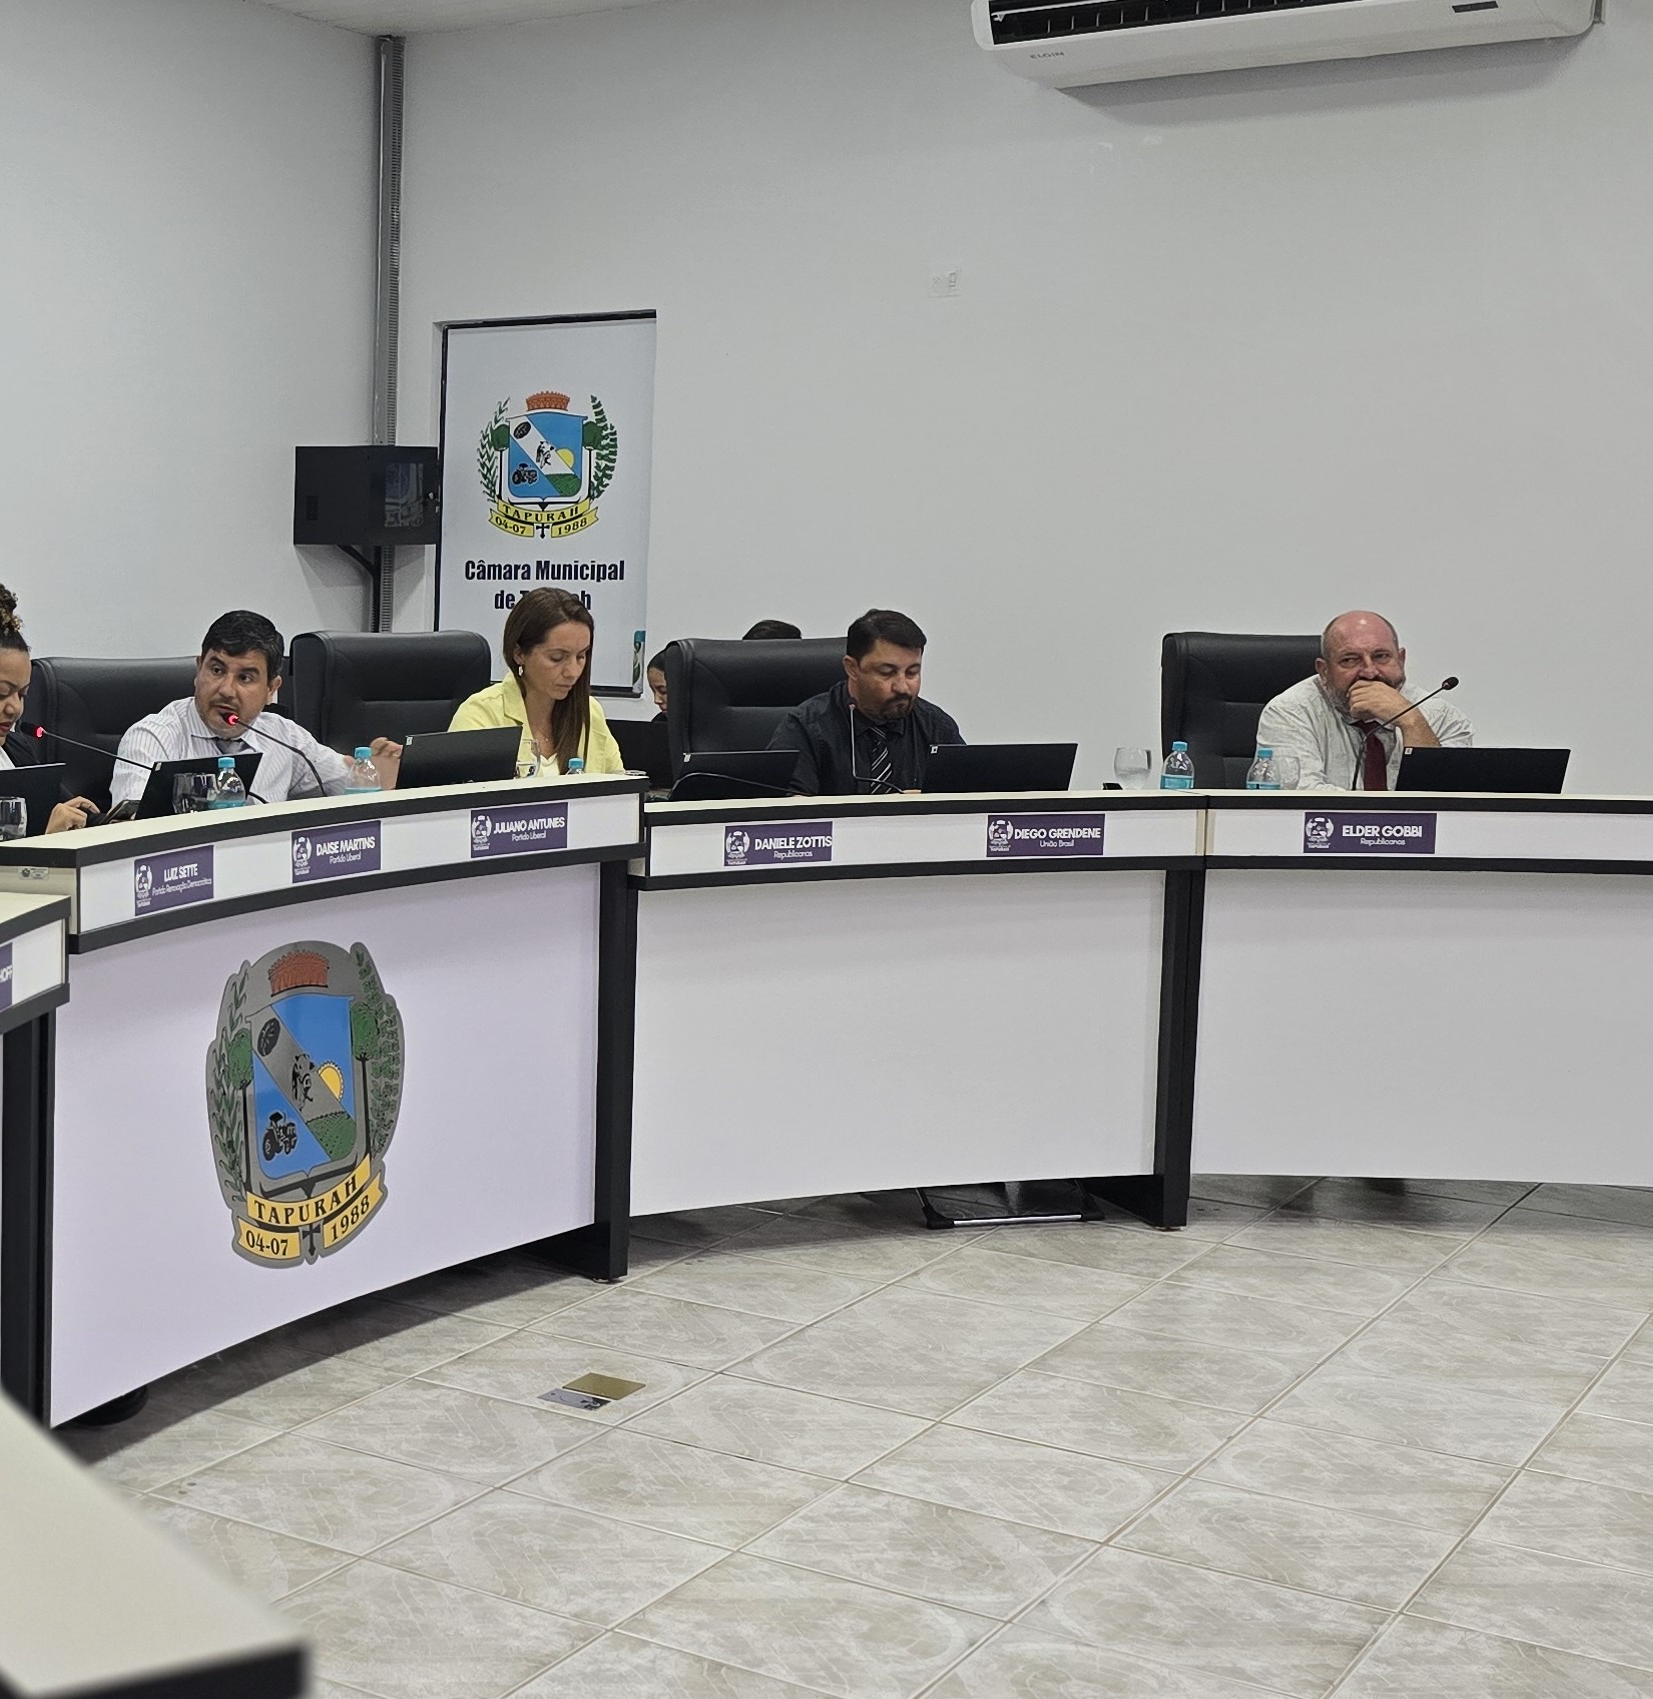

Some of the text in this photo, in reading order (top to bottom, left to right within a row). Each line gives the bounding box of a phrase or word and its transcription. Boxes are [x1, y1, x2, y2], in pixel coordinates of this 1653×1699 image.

[503, 504, 579, 524] TAPURAH
[495, 516, 587, 535] 04-07 1988
[465, 560, 625, 582] Câmara Municipal
[495, 590, 516, 609] de
[494, 816, 566, 834] JULIANO ANTUNES
[1014, 827, 1102, 839] DIEGO GRENDENE
[1342, 825, 1423, 838] ELDER GOBBI
[316, 836, 375, 856] DAISE MARTINS
[755, 835, 833, 850] DANIELE ZOTTIS
[1039, 839, 1074, 847] União Brasil
[1360, 838, 1405, 847] Republicanos
[773, 850, 813, 860] Republicanos
[163, 863, 198, 882] LUIZ SETTE
[253, 1178, 357, 1225] TAPURAH
[330, 1195, 370, 1244] 1988
[246, 1229, 289, 1256] 04-07
